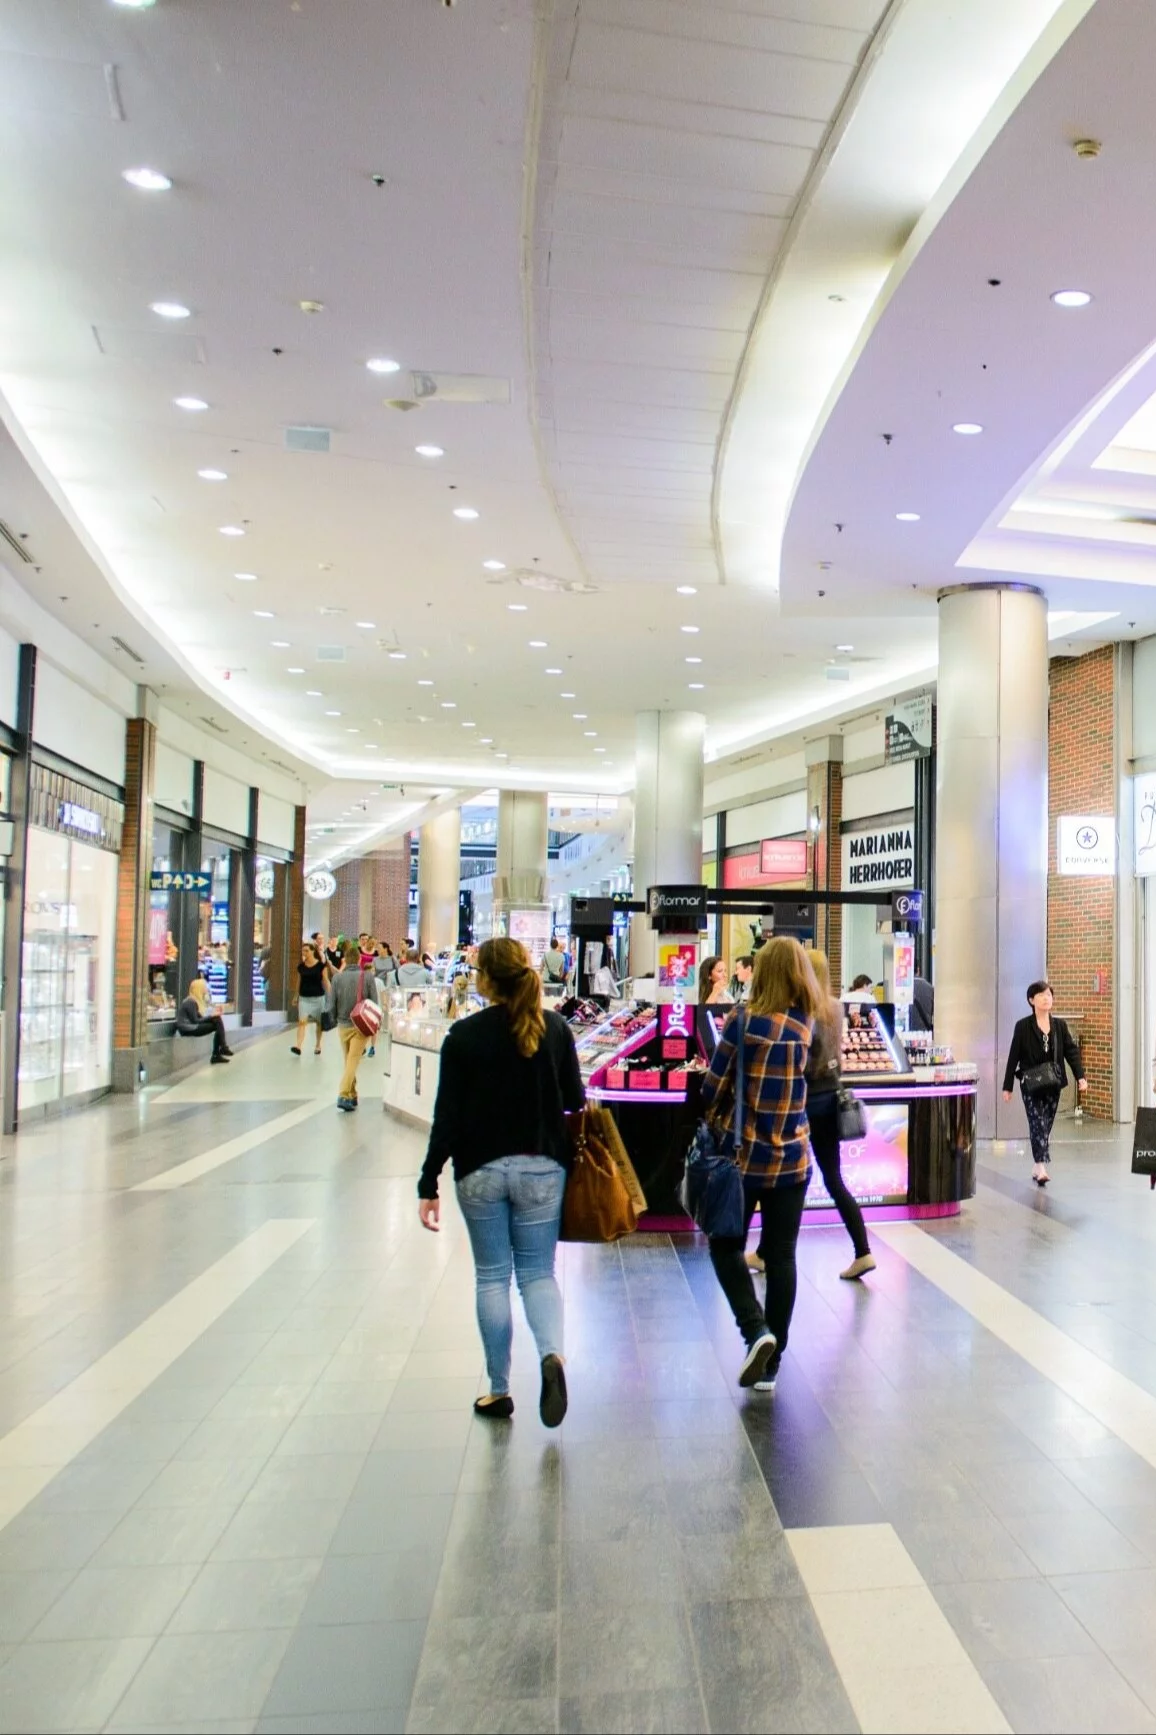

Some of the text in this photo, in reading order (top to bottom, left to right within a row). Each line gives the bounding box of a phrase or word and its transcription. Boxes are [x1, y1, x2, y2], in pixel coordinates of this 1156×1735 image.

[850, 830, 912, 858] MARIANNA
[162, 873, 172, 889] P
[850, 858, 912, 884] HERRHOFER
[659, 893, 701, 906] flormar
